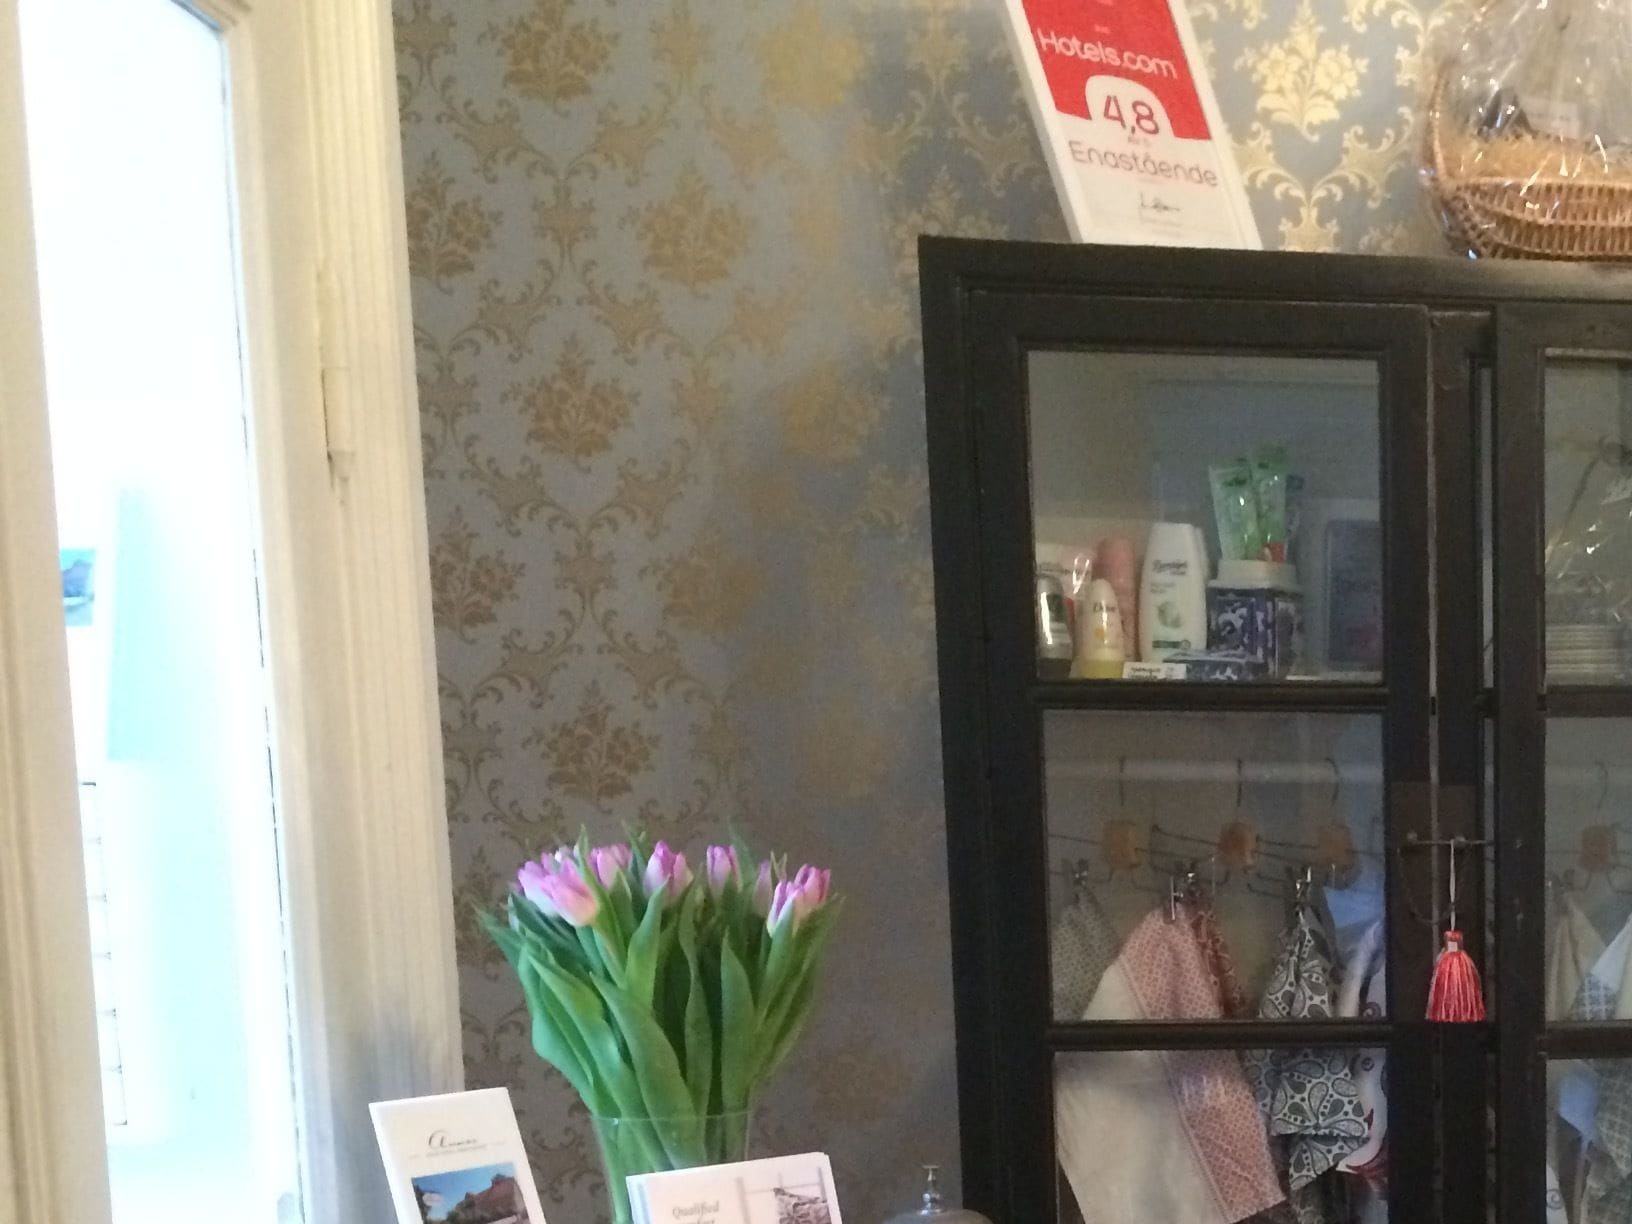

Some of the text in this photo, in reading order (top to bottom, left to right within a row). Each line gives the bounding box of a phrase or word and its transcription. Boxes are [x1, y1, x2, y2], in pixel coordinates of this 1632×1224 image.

[1036, 27, 1178, 80] Hotels.com
[1102, 94, 1160, 136] 4,8
[1068, 140, 1218, 188] Enastående
[672, 1200, 720, 1223] Qualified
